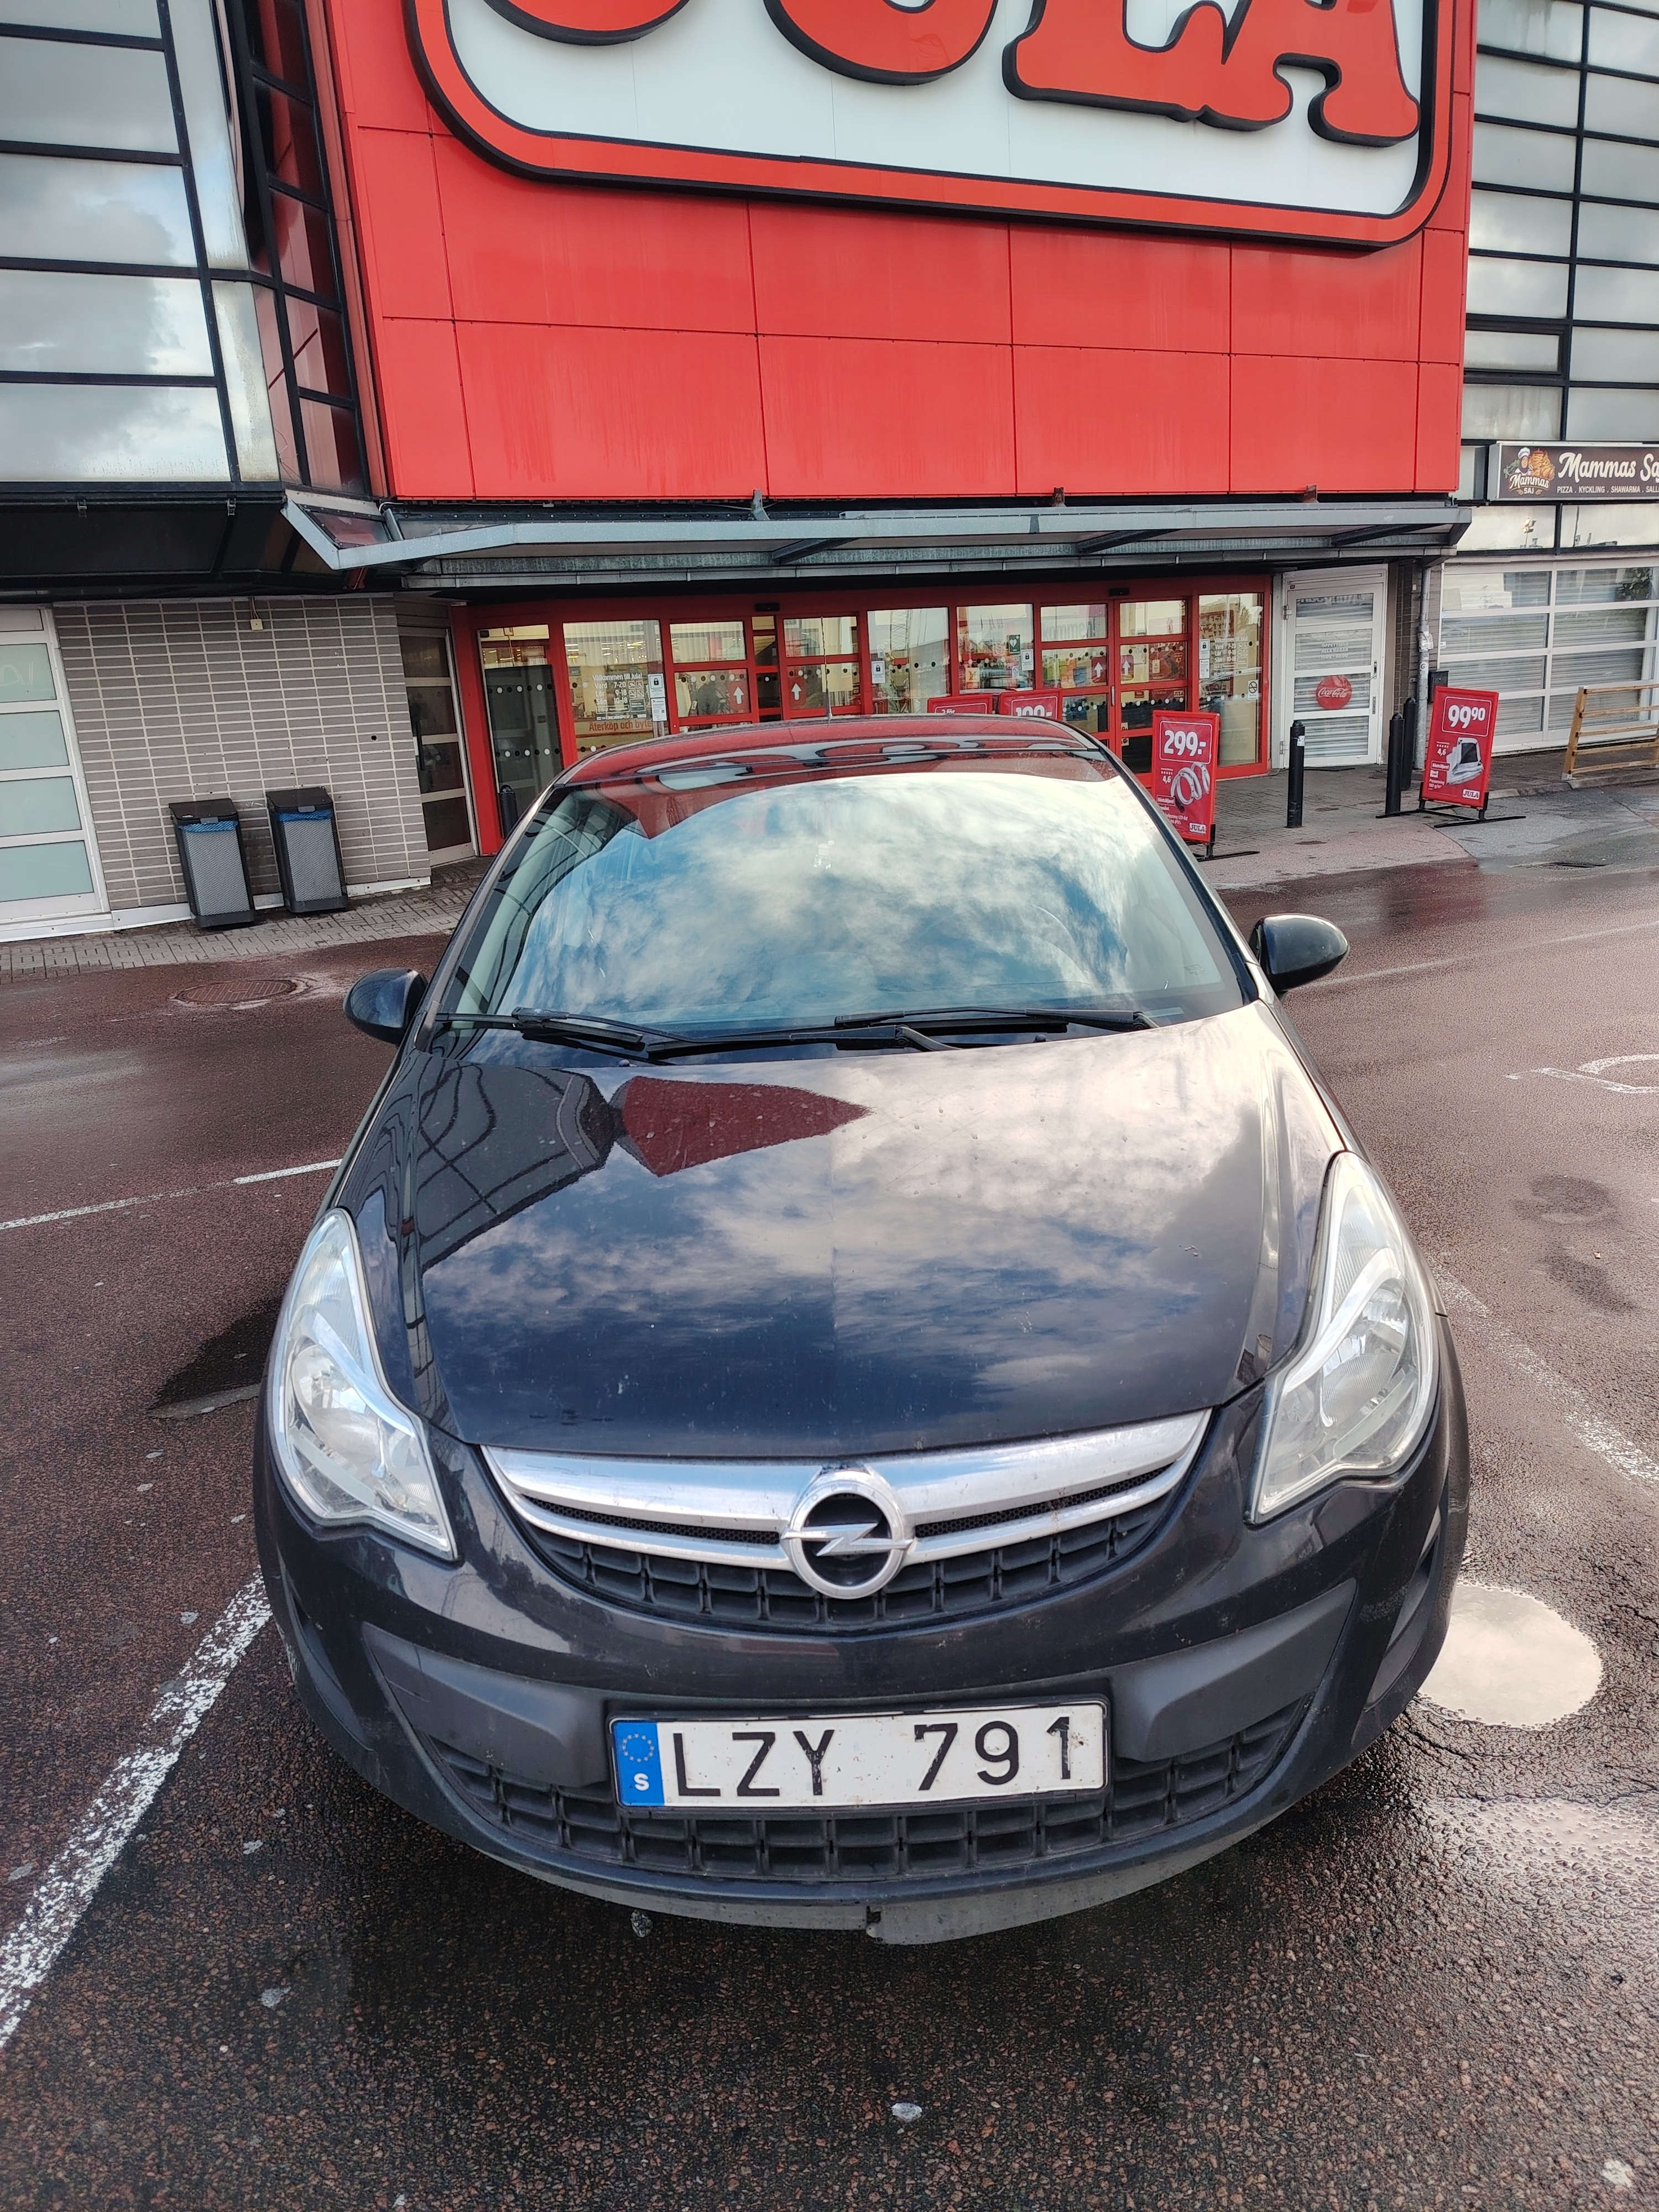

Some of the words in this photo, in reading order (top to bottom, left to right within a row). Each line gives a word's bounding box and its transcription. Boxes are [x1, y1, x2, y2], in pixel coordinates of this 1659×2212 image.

[1558, 452, 1636, 483] Mammas
[1640, 453, 1659, 483] Sa
[1509, 473, 1550, 489] Mammas
[1557, 486, 1573, 494] PIZZA
[589, 721, 618, 731] Återköp
[620, 720, 633, 729] och
[1437, 748, 1447, 757] 4,6
[1162, 775, 1171, 784] 4,6
[1190, 824, 1205, 832] JULA
[672, 1729, 836, 1797] LZY
[914, 1716, 1072, 1792] 791
[634, 1772, 650, 1791] S
